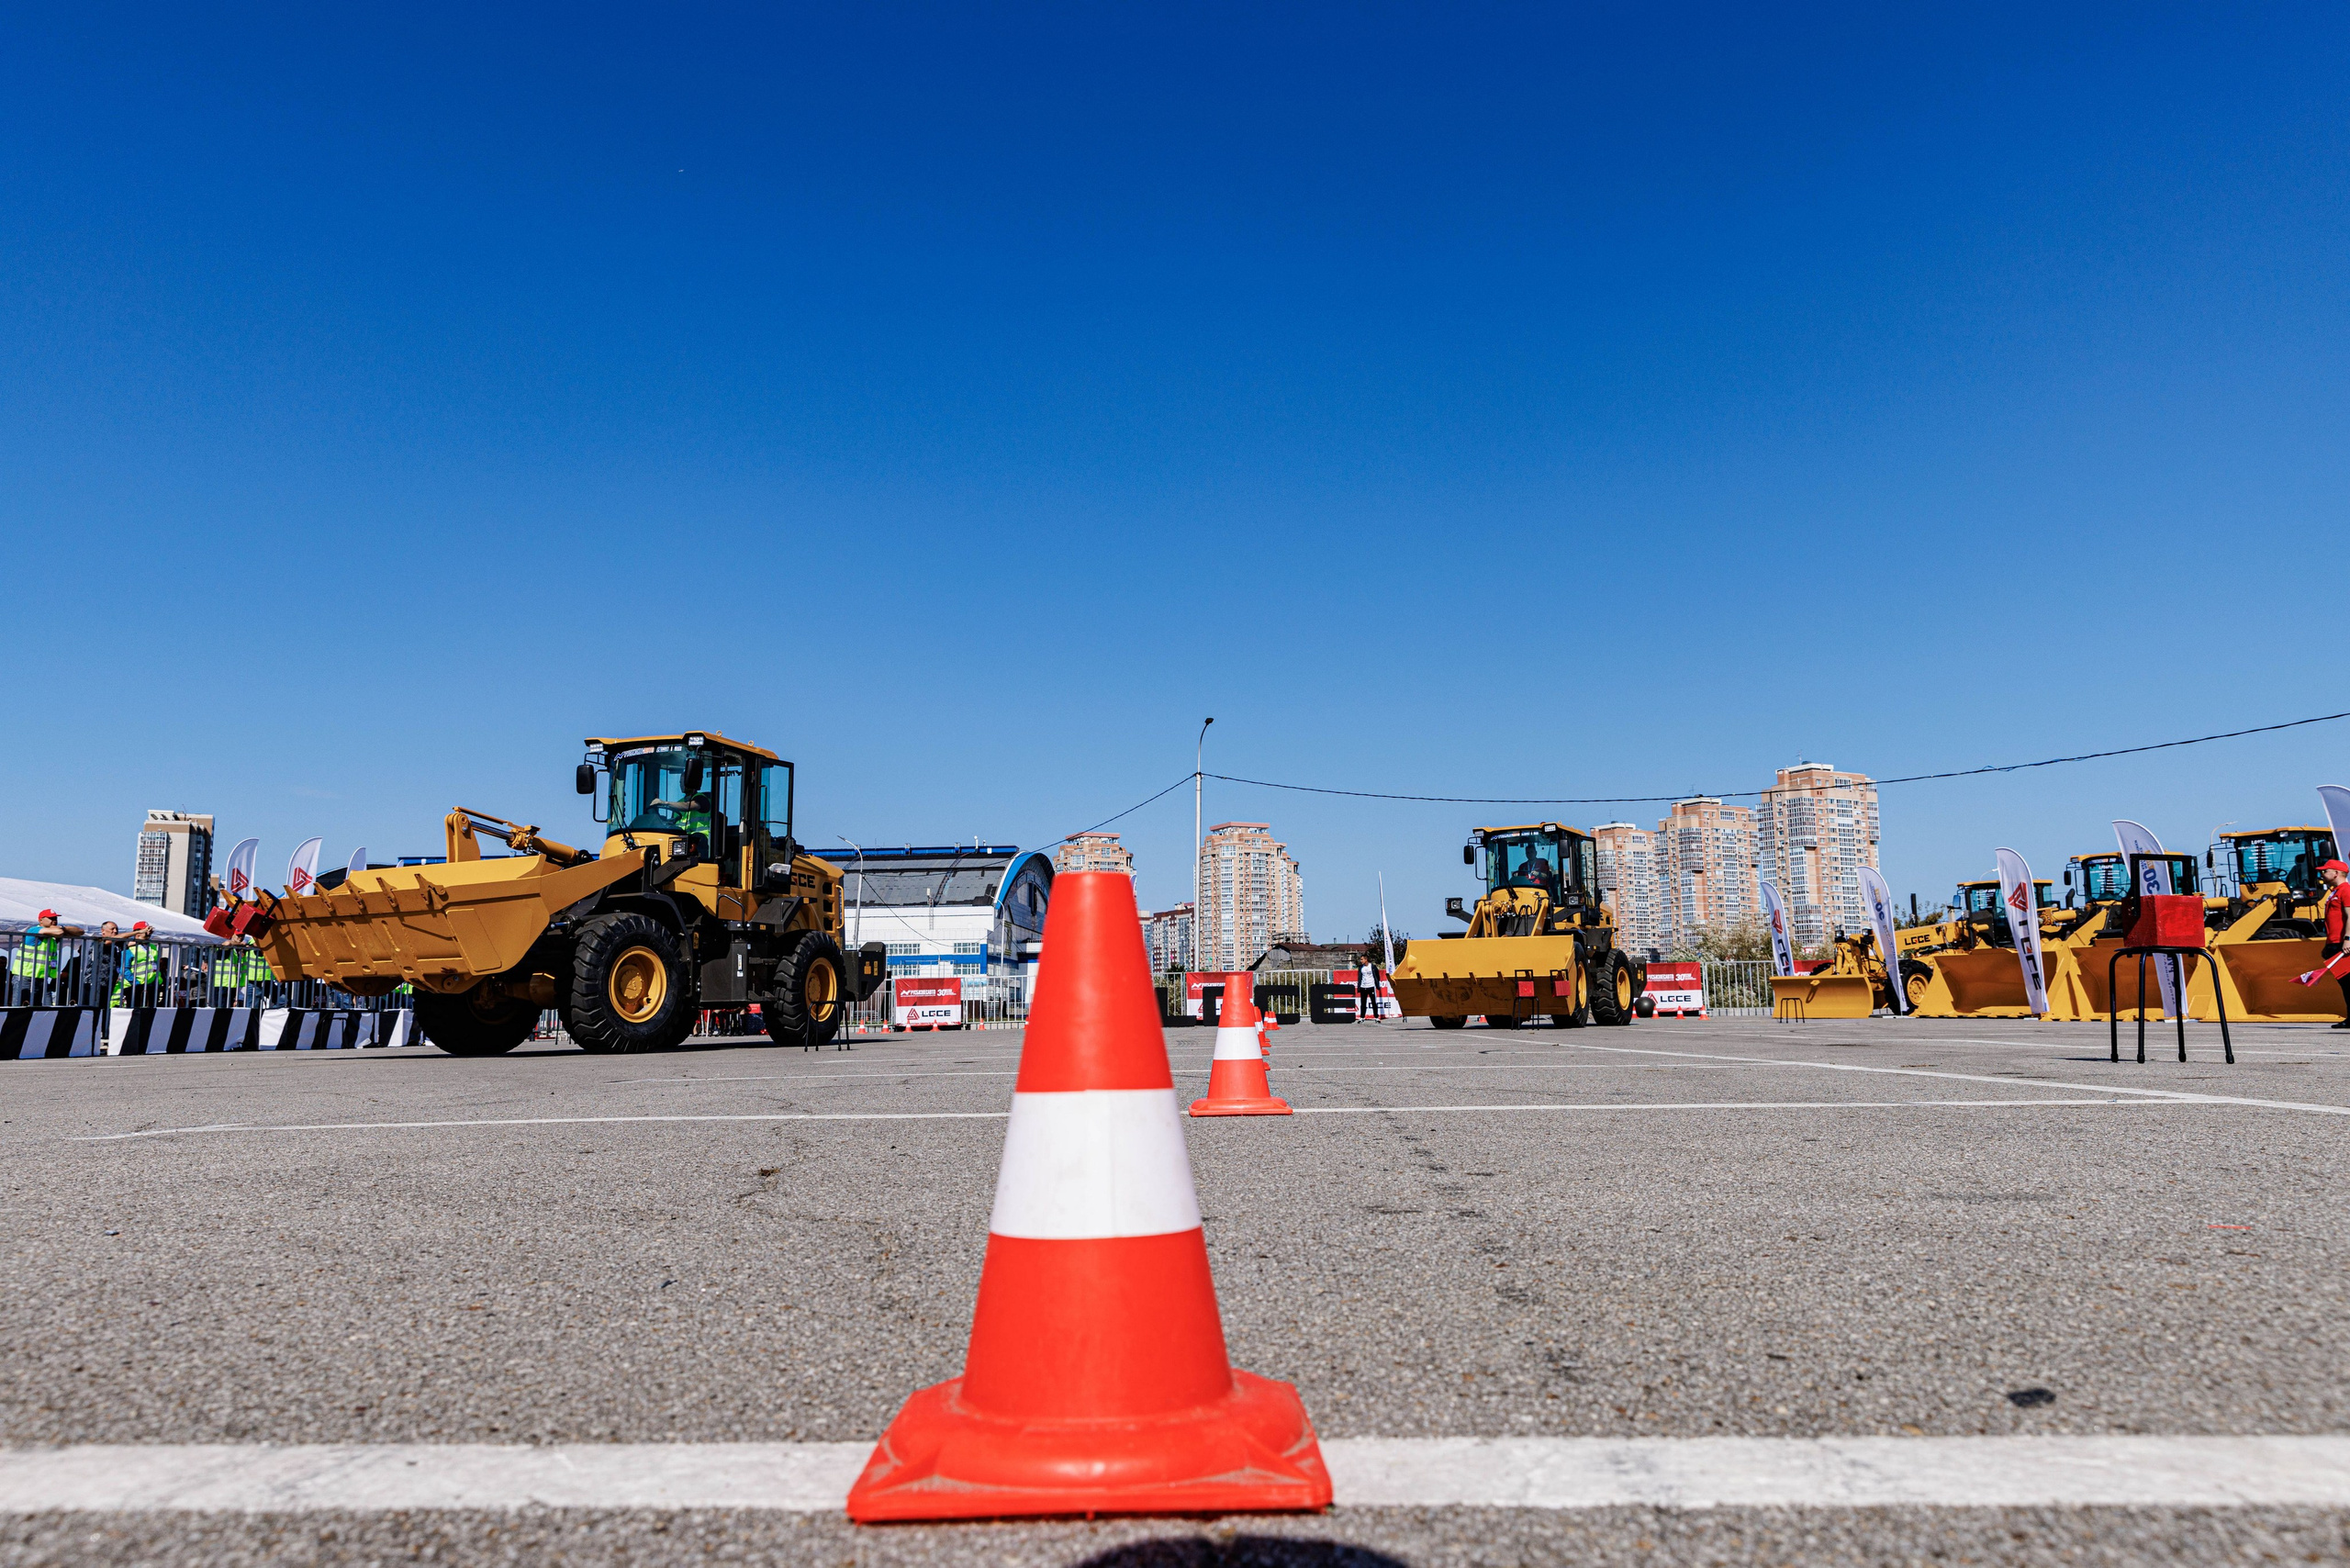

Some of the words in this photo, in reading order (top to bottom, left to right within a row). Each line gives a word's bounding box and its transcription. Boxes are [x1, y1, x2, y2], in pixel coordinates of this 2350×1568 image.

[790, 871, 815, 889] GCE
[2143, 868, 2160, 894] 30
[1904, 934, 1930, 946] LGCE
[1675, 973, 1686, 981] 30
[936, 989, 946, 997] 30
[1660, 994, 1692, 1003] LGCE
[921, 1010, 951, 1018] LGCE
